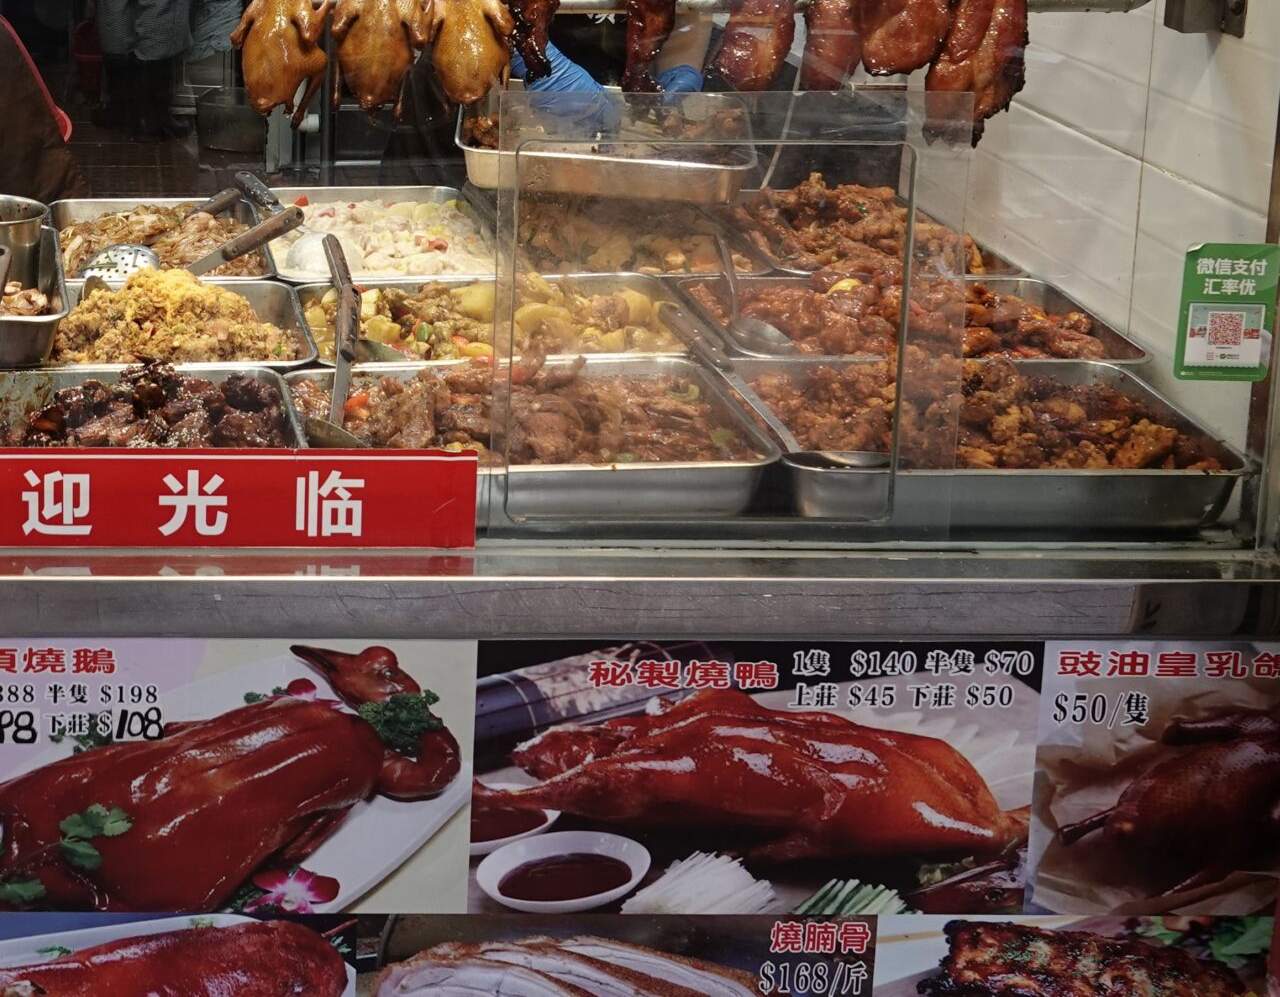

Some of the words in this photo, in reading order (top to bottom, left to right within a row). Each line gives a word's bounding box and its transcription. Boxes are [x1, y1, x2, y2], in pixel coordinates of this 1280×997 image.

[1196, 257, 1269, 277] 微信支付
[1202, 278, 1257, 296] 汇率优
[588, 659, 780, 690] 秘製燒鴨
[793, 650, 830, 676] 1隻
[851, 650, 918, 677] $140
[925, 650, 976, 676] 半隻
[984, 649, 1036, 677] $70
[45, 683, 89, 704] 半隻
[100, 683, 159, 705] $198
[788, 683, 838, 709] 上莊
[848, 684, 896, 708] $45
[907, 684, 956, 709] 下莊
[966, 684, 1014, 708] $50
[1052, 691, 1149, 729] $50/隻
[45, 713, 89, 735] 下莊
[770, 921, 871, 954] 燒腩骨
[759, 961, 869, 996] $168/斤
